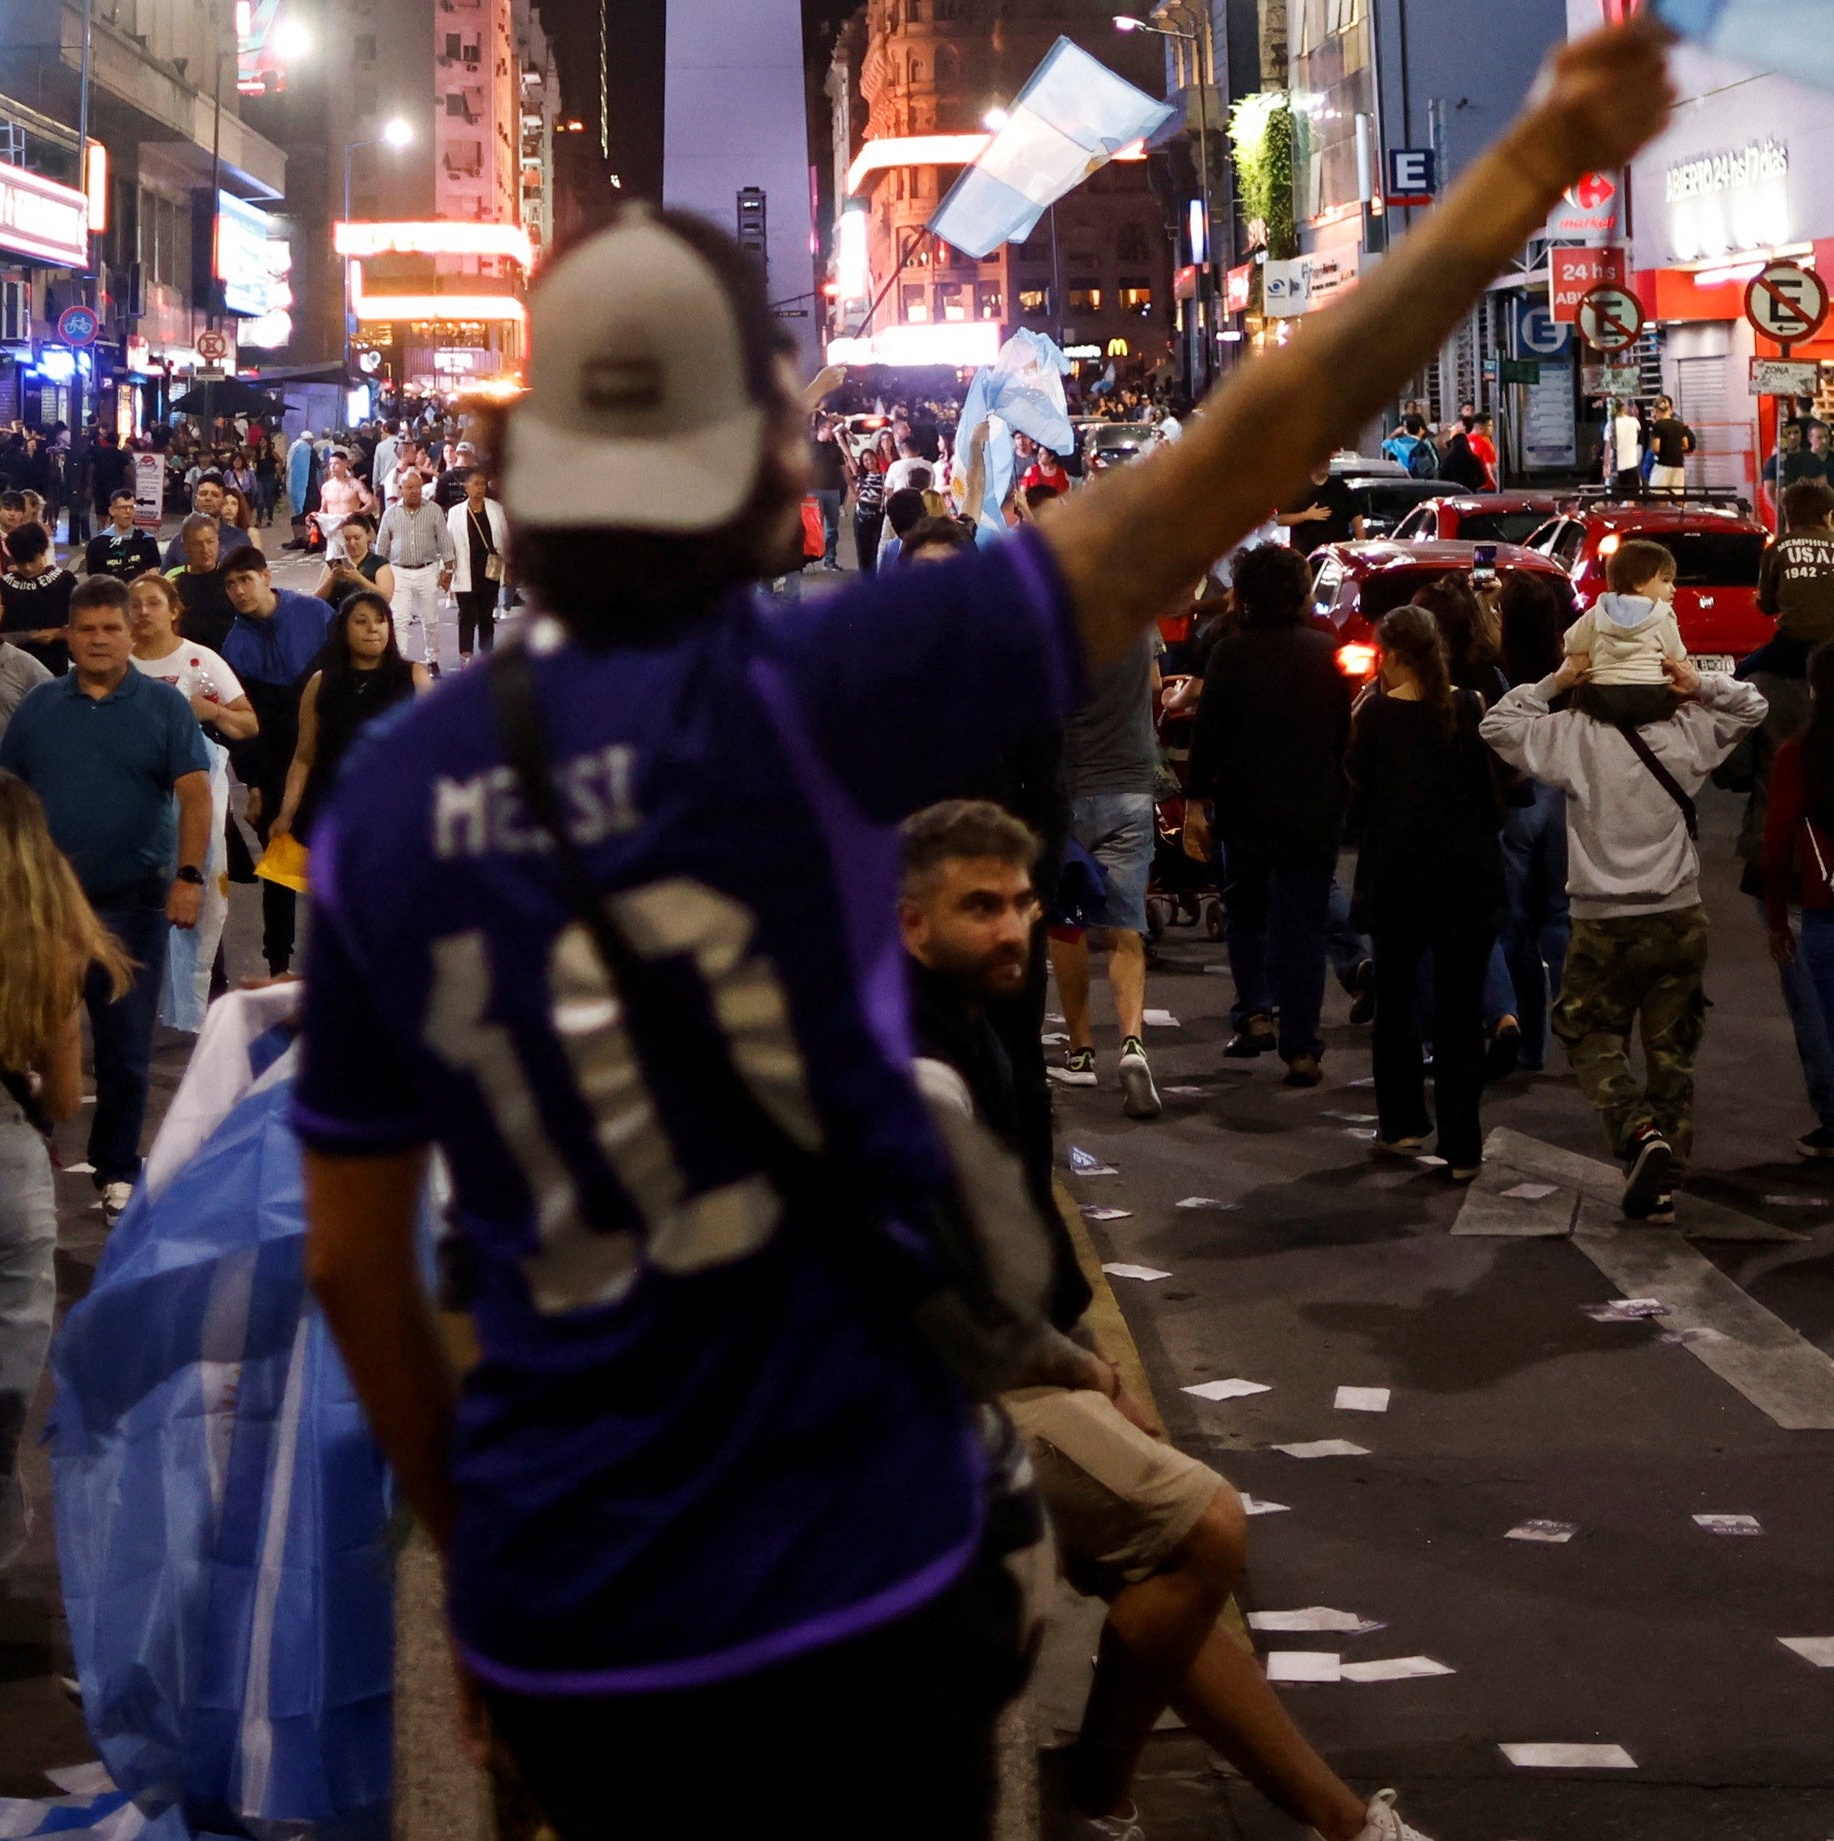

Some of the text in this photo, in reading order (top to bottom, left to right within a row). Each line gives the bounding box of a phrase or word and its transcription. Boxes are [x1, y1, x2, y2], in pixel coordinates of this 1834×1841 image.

[1396, 153, 1427, 189] E
[1559, 215, 1615, 231] market
[1563, 263, 1587, 280] 24
[1531, 314, 1557, 344] E
[1777, 538, 1829, 553] MEMPHIS
[1784, 566, 1817, 580] 1942
[431, 743, 643, 860] MESI
[421, 875, 825, 1317] 10
